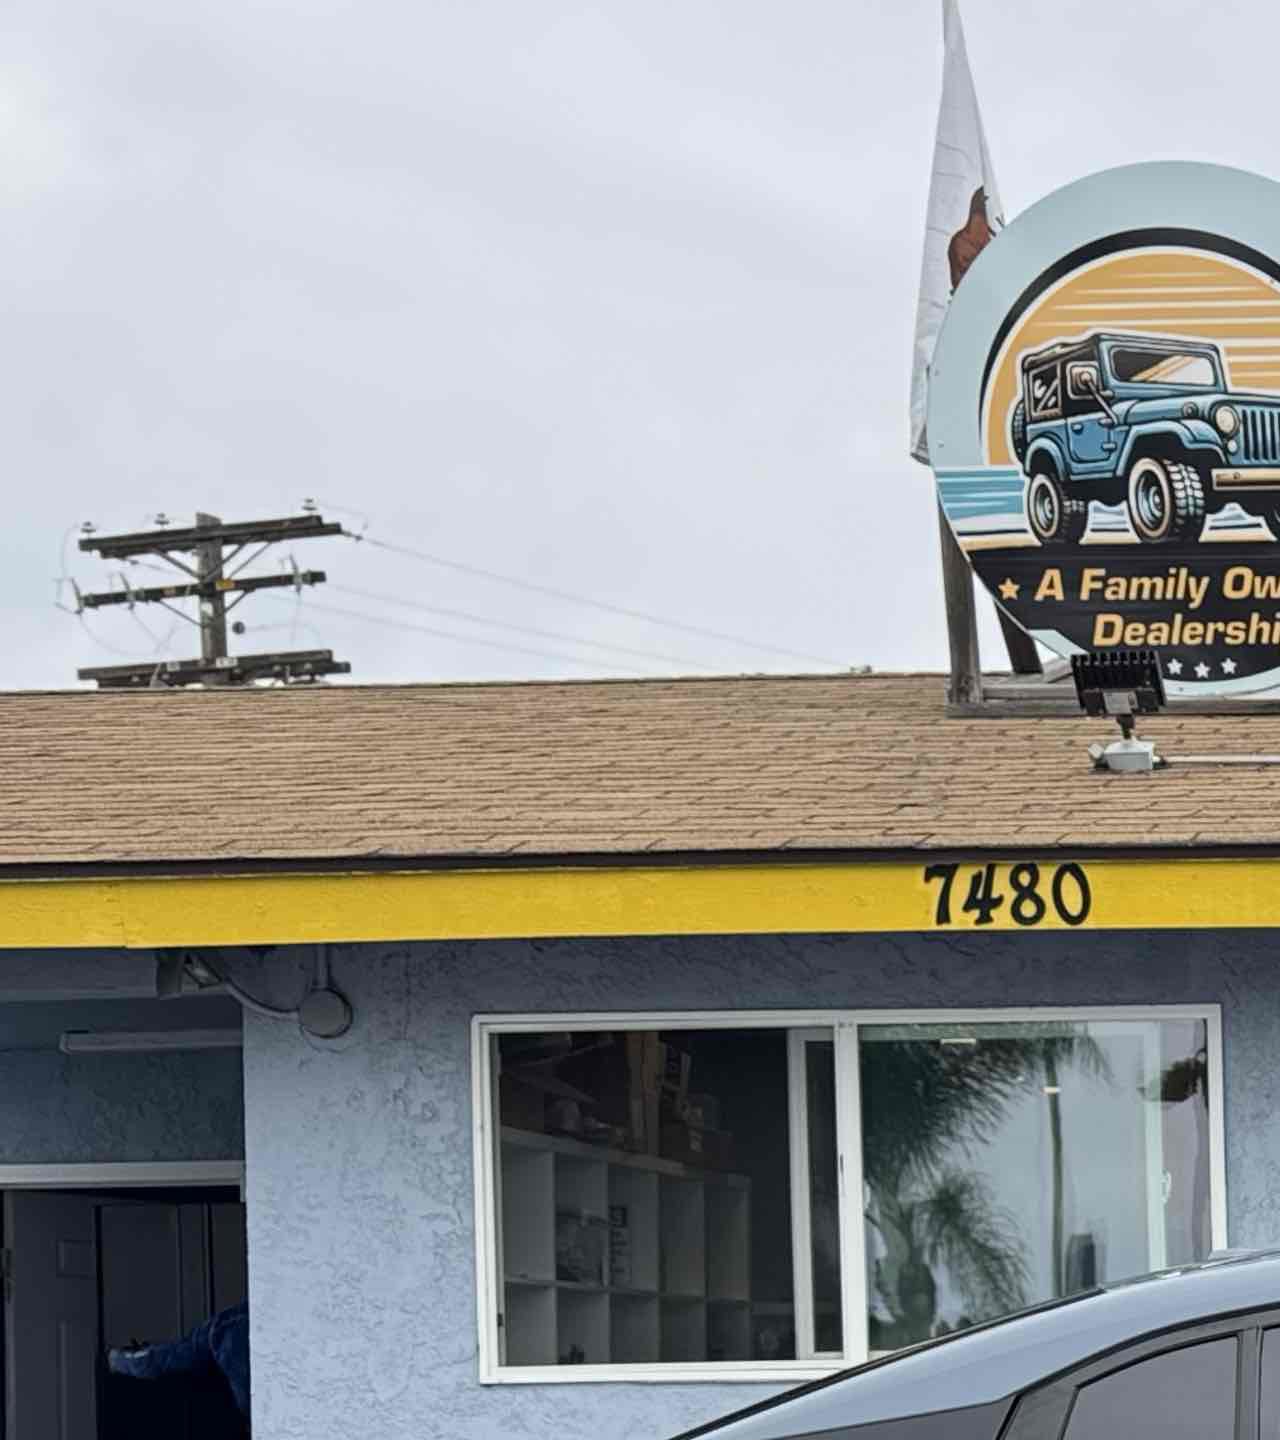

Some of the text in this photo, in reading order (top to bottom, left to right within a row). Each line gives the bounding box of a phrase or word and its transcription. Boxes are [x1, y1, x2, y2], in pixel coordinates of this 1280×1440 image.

[1034, 568, 1065, 601] A
[1079, 567, 1210, 609] Family
[924, 862, 1092, 926] 7480
